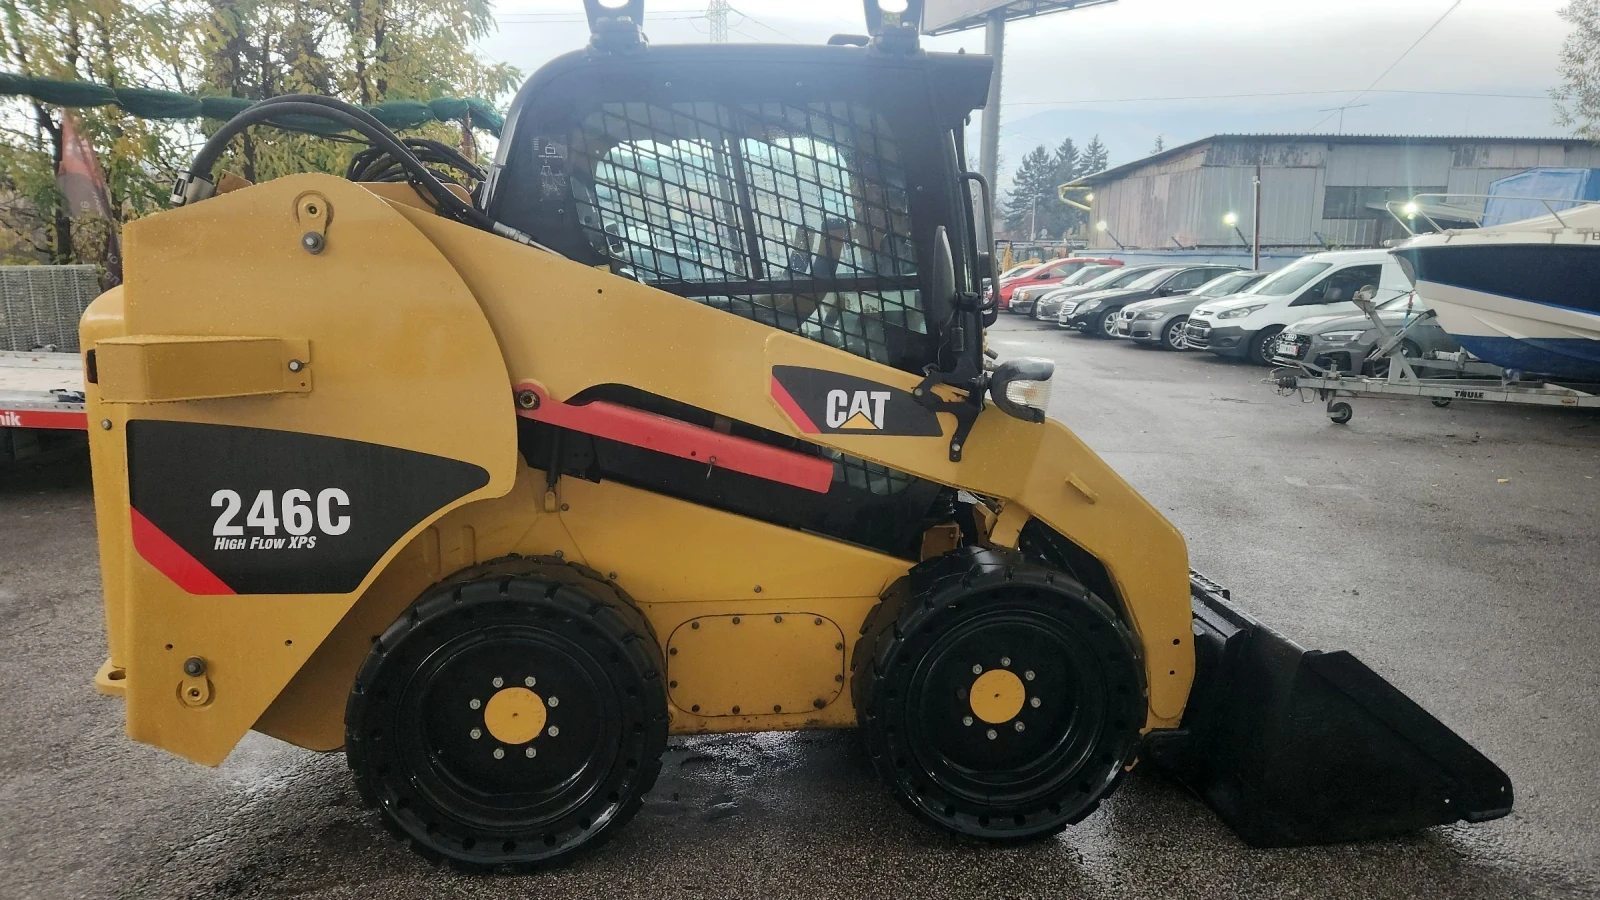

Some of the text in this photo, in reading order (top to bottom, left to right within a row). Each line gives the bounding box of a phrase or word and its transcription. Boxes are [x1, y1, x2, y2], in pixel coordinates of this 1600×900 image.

[1454, 390, 1484, 399] THULE
[826, 389, 891, 430] CAT
[210, 487, 351, 536] 246C
[288, 535, 317, 549] XPS
